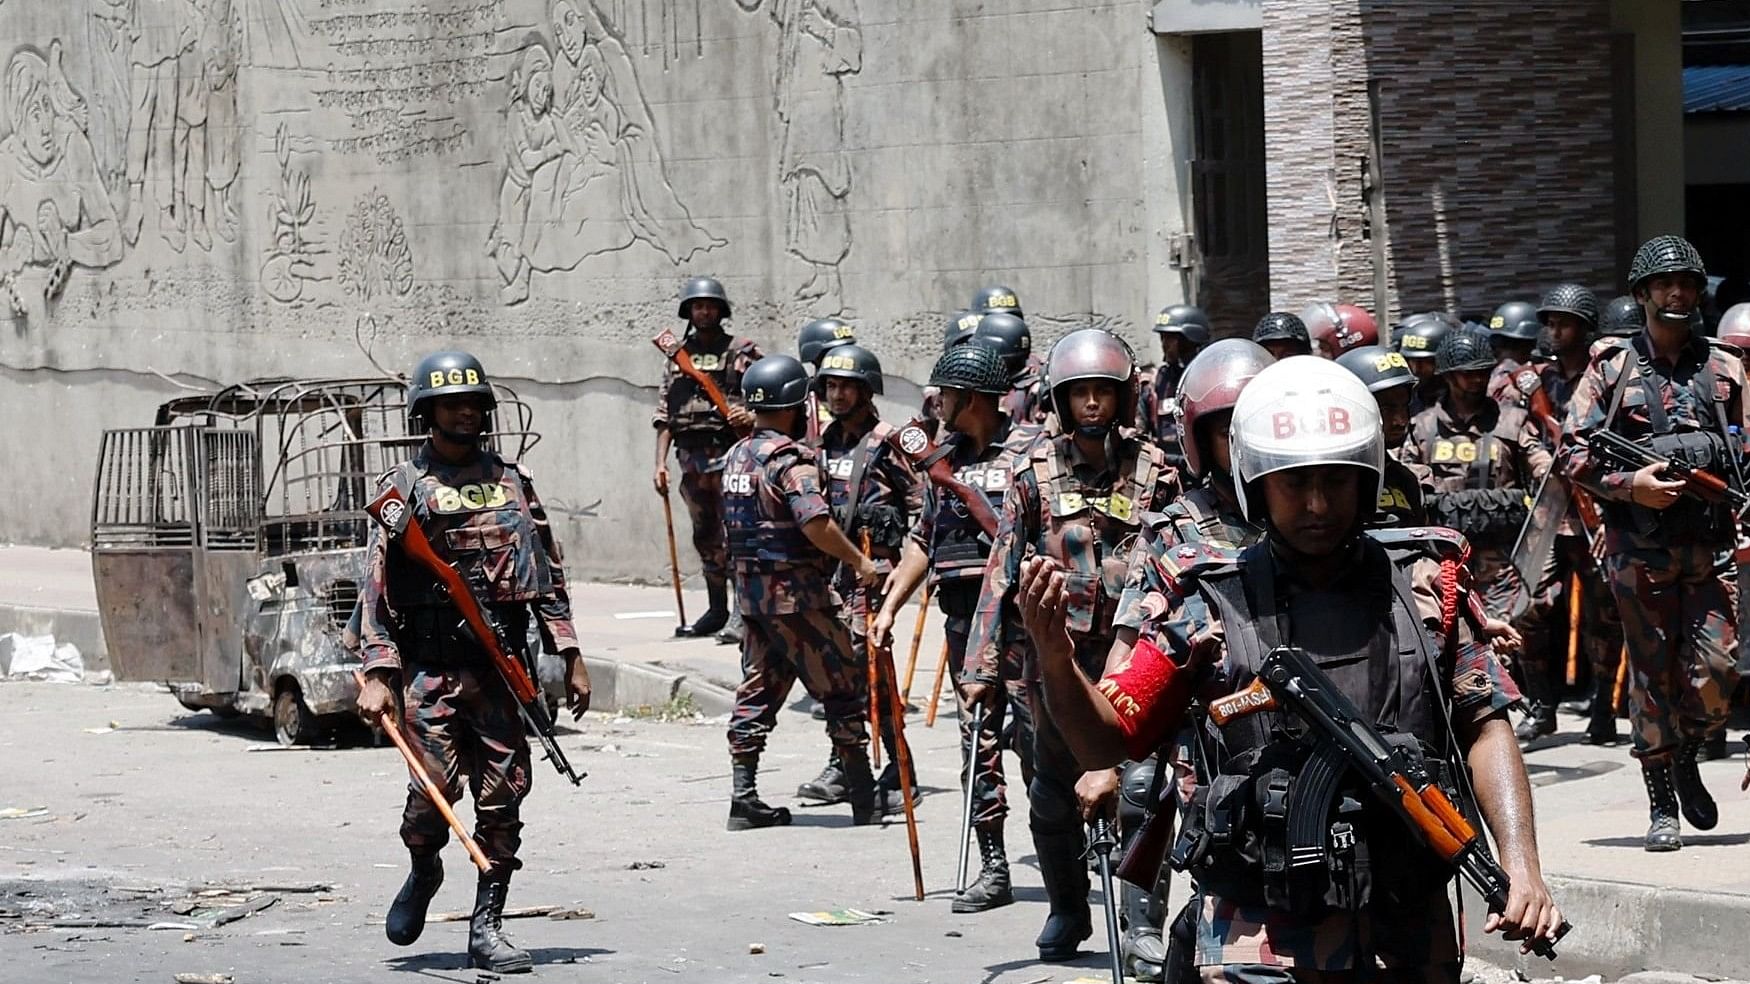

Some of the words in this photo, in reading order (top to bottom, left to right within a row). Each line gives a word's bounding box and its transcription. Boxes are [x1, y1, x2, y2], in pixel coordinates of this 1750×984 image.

[430, 368, 480, 388] BGB
[1434, 441, 1498, 462] BG
[435, 483, 507, 512] BGB
